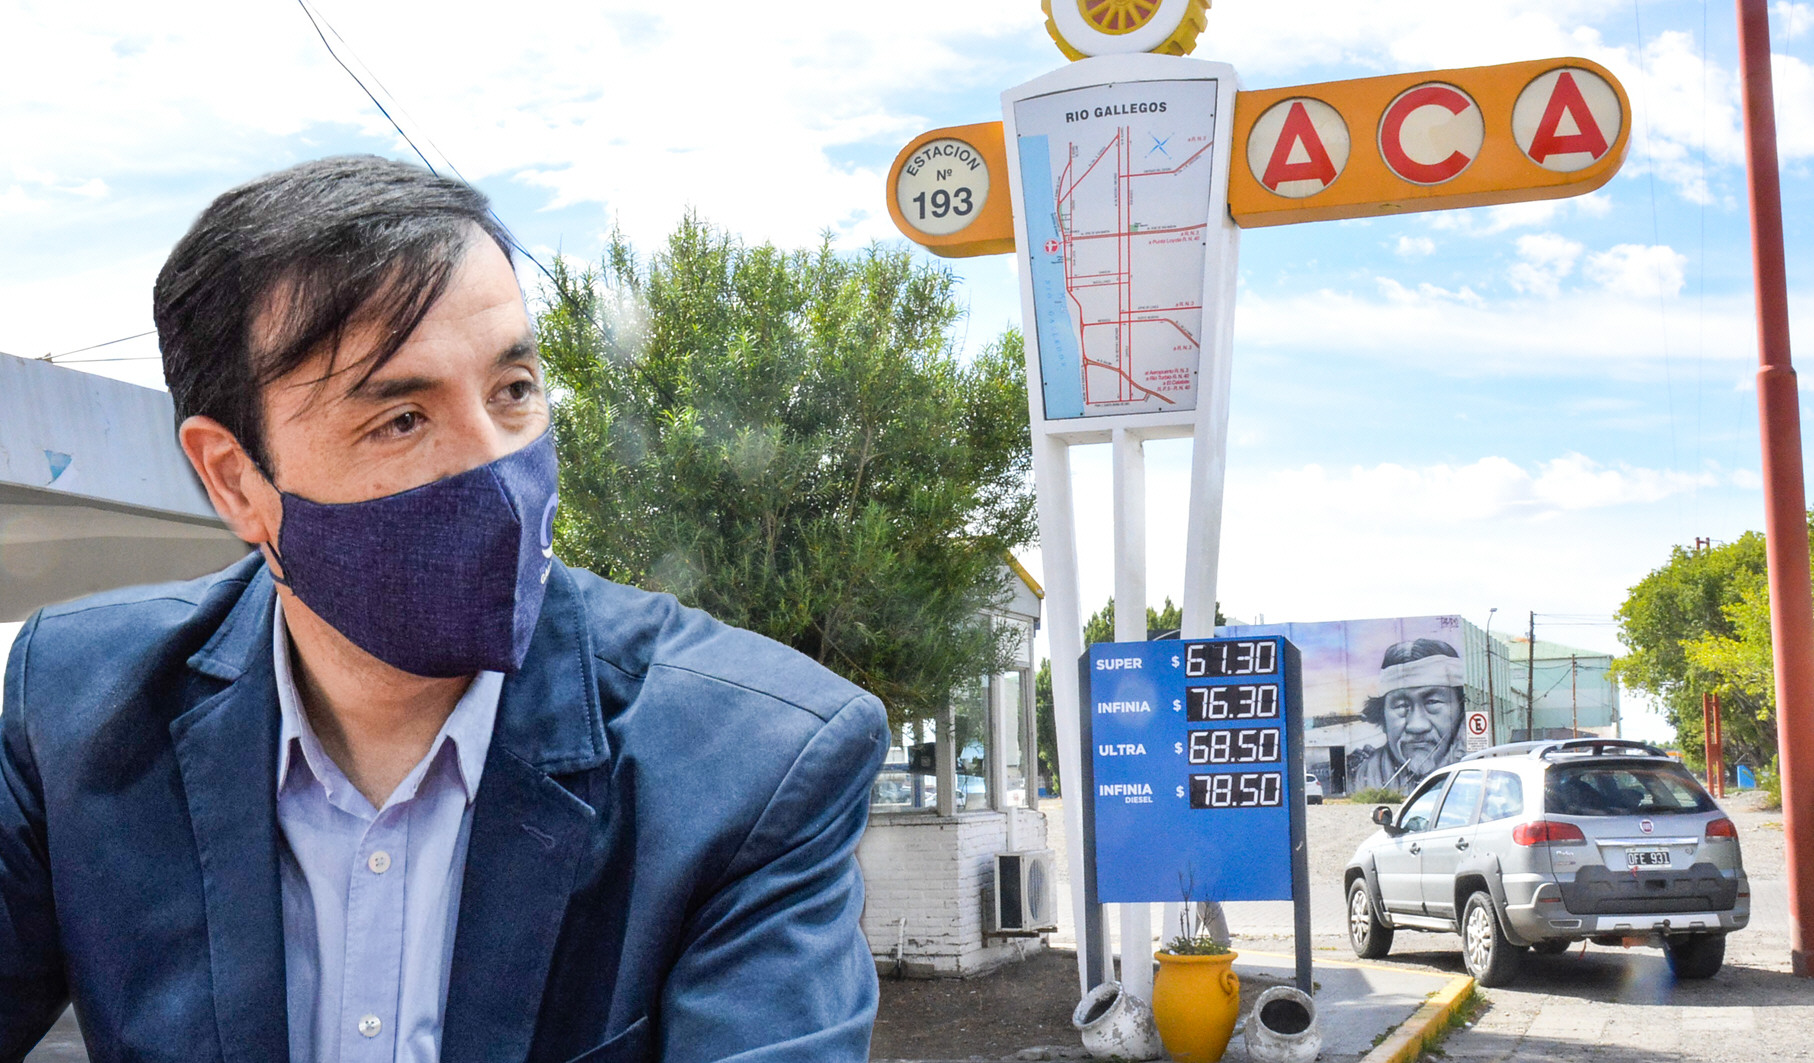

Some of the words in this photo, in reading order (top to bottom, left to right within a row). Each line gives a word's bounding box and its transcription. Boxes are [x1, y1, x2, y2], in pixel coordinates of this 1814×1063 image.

[1066, 110, 1089, 123] RIO
[1094, 102, 1167, 118] GALLEGOS
[906, 144, 980, 176] ESTACION
[913, 187, 973, 219] 193
[1096, 657, 1142, 670] SUPER
[1171, 655, 1180, 668] $
[1186, 642, 1276, 676] 61.30
[1098, 702, 1151, 713] INFINIA
[1173, 699, 1181, 712] $
[1190, 685, 1278, 719] 76.30
[1099, 744, 1147, 756] ULTRA
[1174, 742, 1183, 755] $
[1189, 729, 1279, 764] 68.50
[1099, 783, 1153, 796] INFINIA
[1176, 785, 1185, 798] $
[1194, 773, 1281, 807] 78.50
[1125, 796, 1153, 804] DIESEL
[1628, 853, 1646, 865] OFE
[1651, 852, 1669, 864] 931
